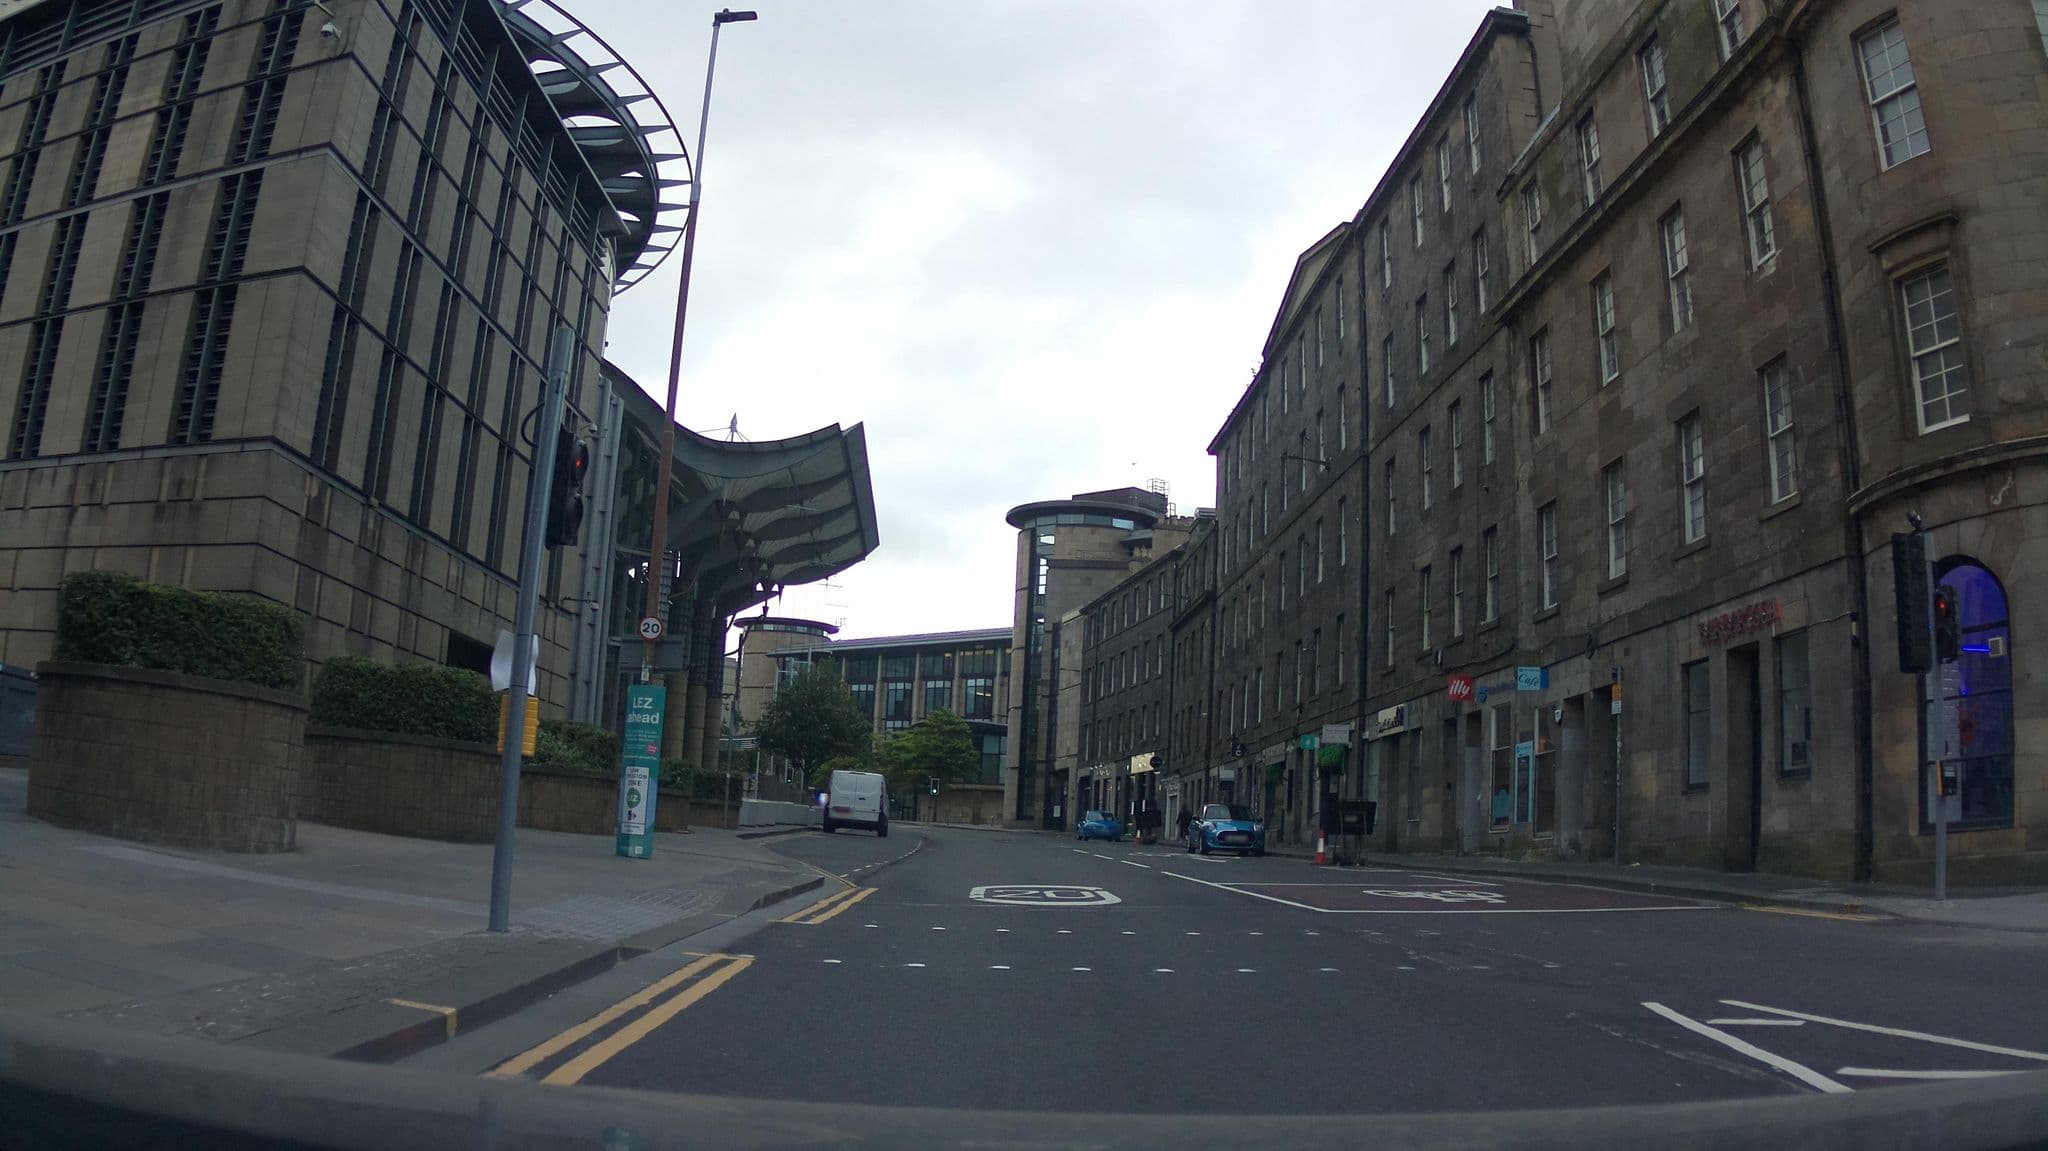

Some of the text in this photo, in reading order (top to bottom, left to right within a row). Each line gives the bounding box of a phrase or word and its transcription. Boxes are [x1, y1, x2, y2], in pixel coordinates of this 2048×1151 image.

[643, 622, 659, 633] 20
[1449, 680, 1470, 698] illy
[633, 697, 653, 708] LEZ
[627, 711, 660, 724] ahead
[993, 890, 1095, 898] 20
